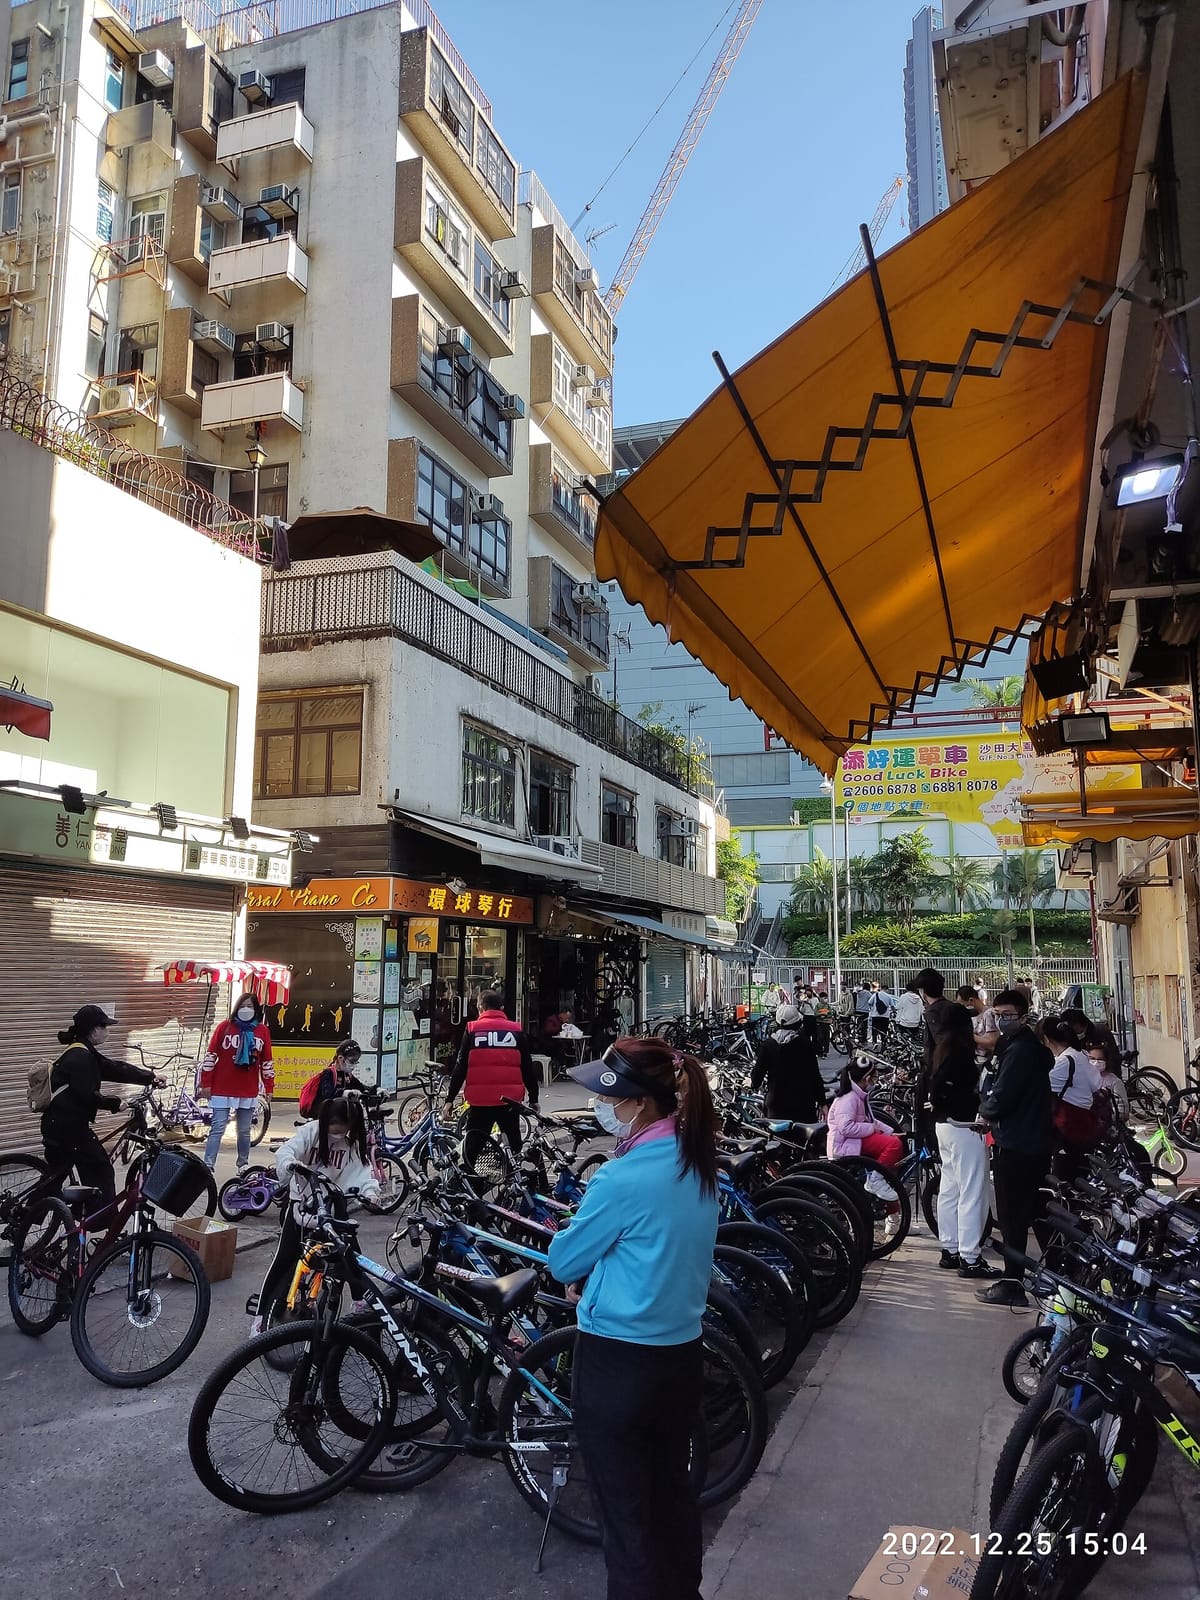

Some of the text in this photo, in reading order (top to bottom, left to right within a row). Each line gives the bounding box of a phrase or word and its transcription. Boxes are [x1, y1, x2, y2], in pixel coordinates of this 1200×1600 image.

[842, 745, 968, 770] 添好運單車
[842, 767, 968, 782] Good Luck Bike
[854, 780, 998, 796] 2606 6878 6881 8078
[75, 818, 128, 843] 仁愛堂
[290, 887, 341, 907] Piano
[351, 881, 377, 907] Co
[427, 887, 513, 918] 環球琴行
[474, 1031, 517, 1047] FILA
[368, 1295, 432, 1379] TRINX
